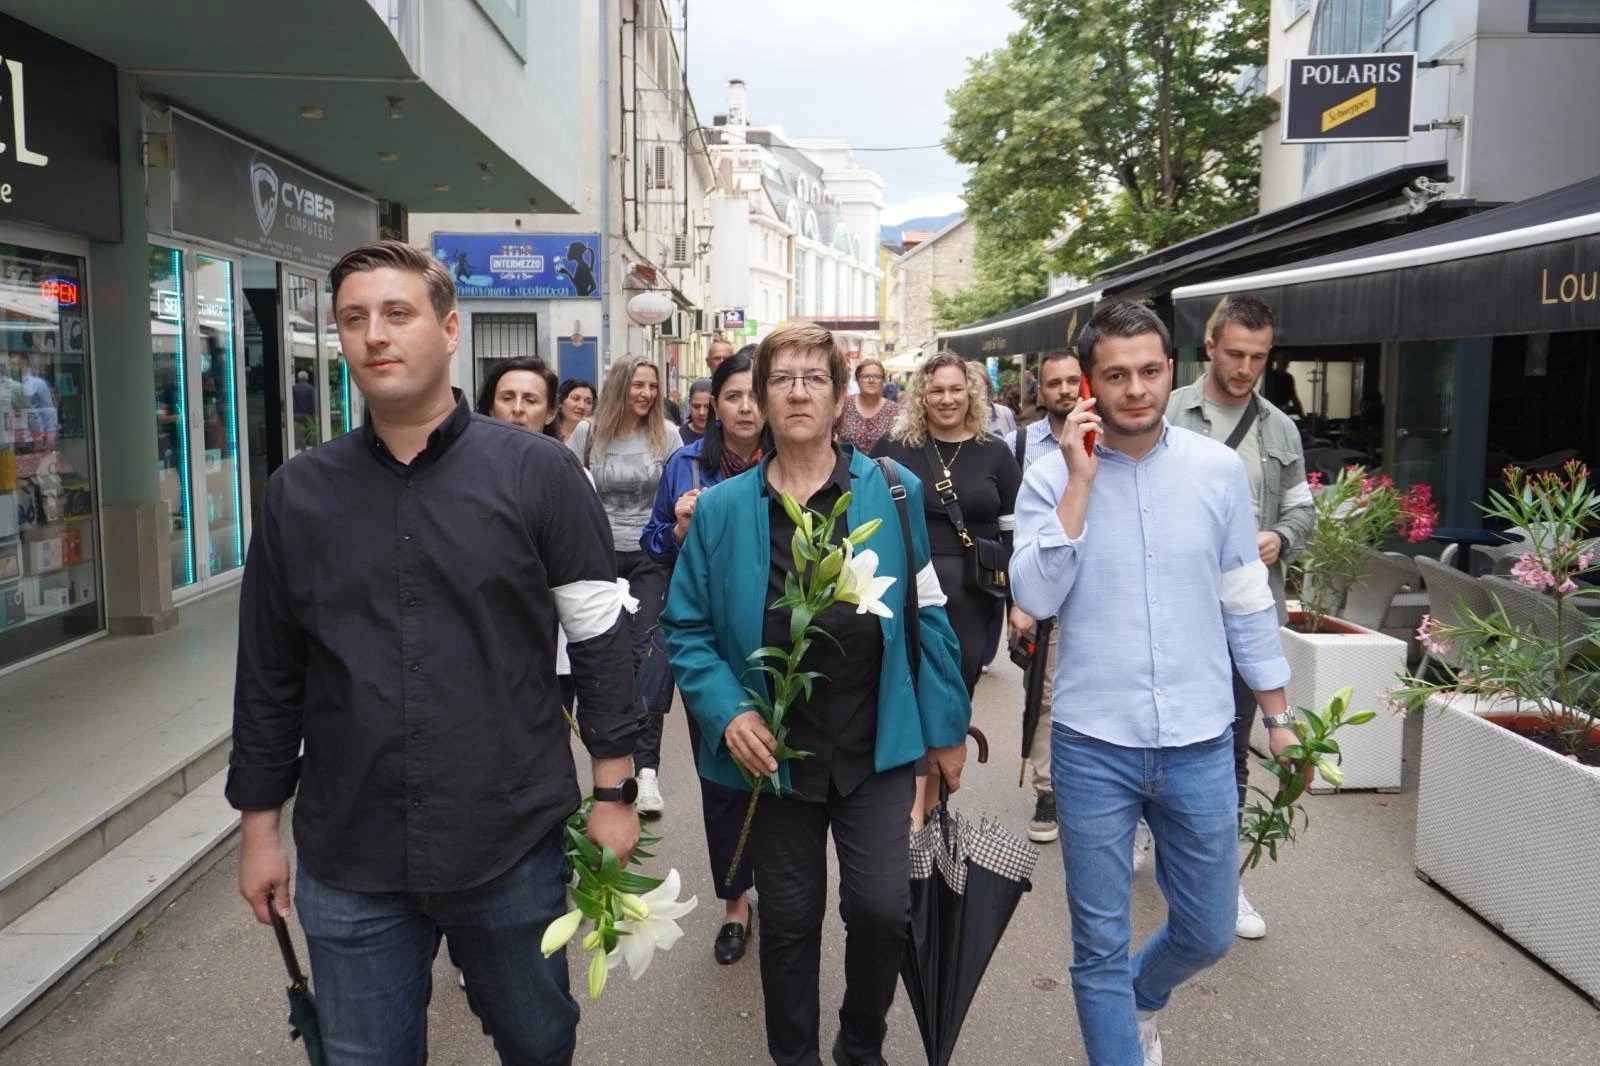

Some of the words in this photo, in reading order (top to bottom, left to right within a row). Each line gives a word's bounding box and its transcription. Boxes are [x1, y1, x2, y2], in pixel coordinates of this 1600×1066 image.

[1301, 63, 1401, 85] POLARIS
[1328, 98, 1370, 123] Schweppes
[281, 182, 334, 223] CYBER
[284, 212, 334, 241] COMPUTERS
[493, 259, 541, 269] INTERMEZZO
[42, 280, 77, 303] OPEN
